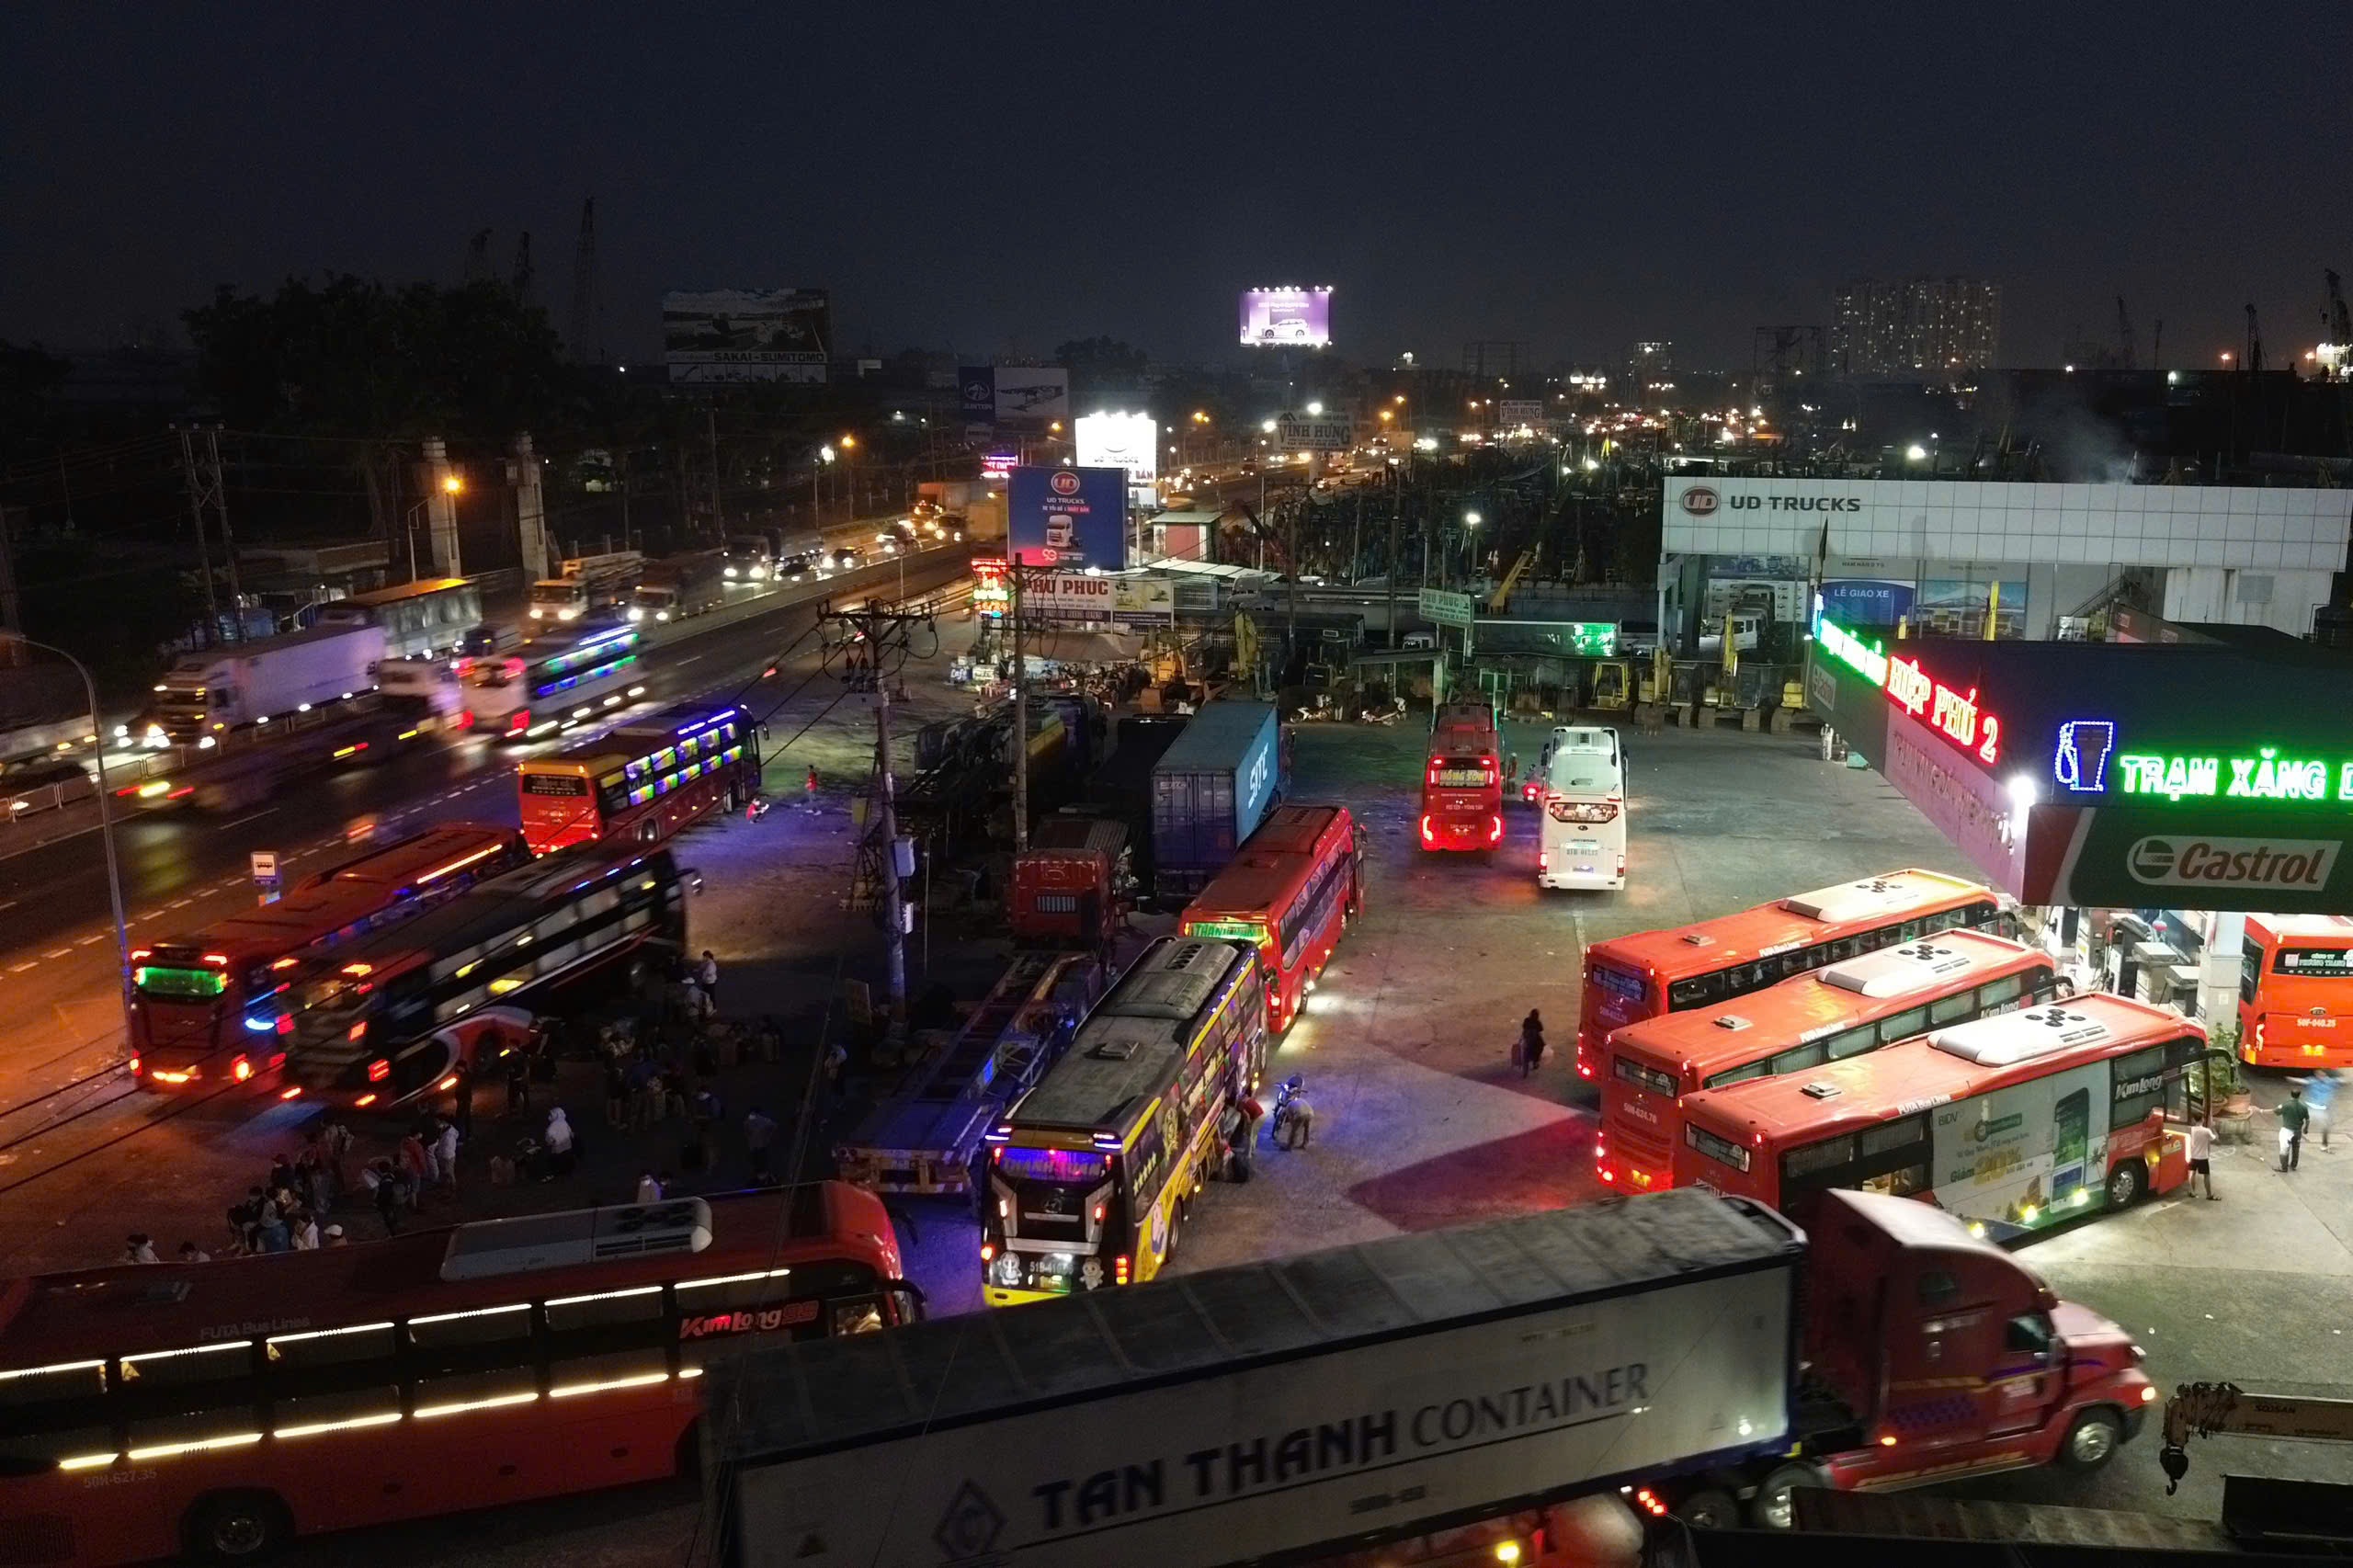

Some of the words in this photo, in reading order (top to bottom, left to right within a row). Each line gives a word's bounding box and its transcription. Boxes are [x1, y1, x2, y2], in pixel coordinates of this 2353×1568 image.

[1730, 496, 1761, 510] UD
[1768, 496, 1861, 512] TRUCKS
[1848, 589, 1875, 598] GIAO
[1875, 590, 1890, 598] XE
[1979, 716, 1999, 764] 2
[2120, 755, 2219, 801] TRẠM
[2225, 747, 2328, 801] XĂNG
[2177, 842, 2325, 884] Castrol
[1938, 1111, 1959, 1126] BIDV
[200, 1323, 240, 1340] FUTA
[243, 1319, 270, 1334] Bus
[271, 1315, 311, 1331] Lines
[1186, 1409, 1396, 1495] THANH
[1412, 1363, 1651, 1449] CONTAINER
